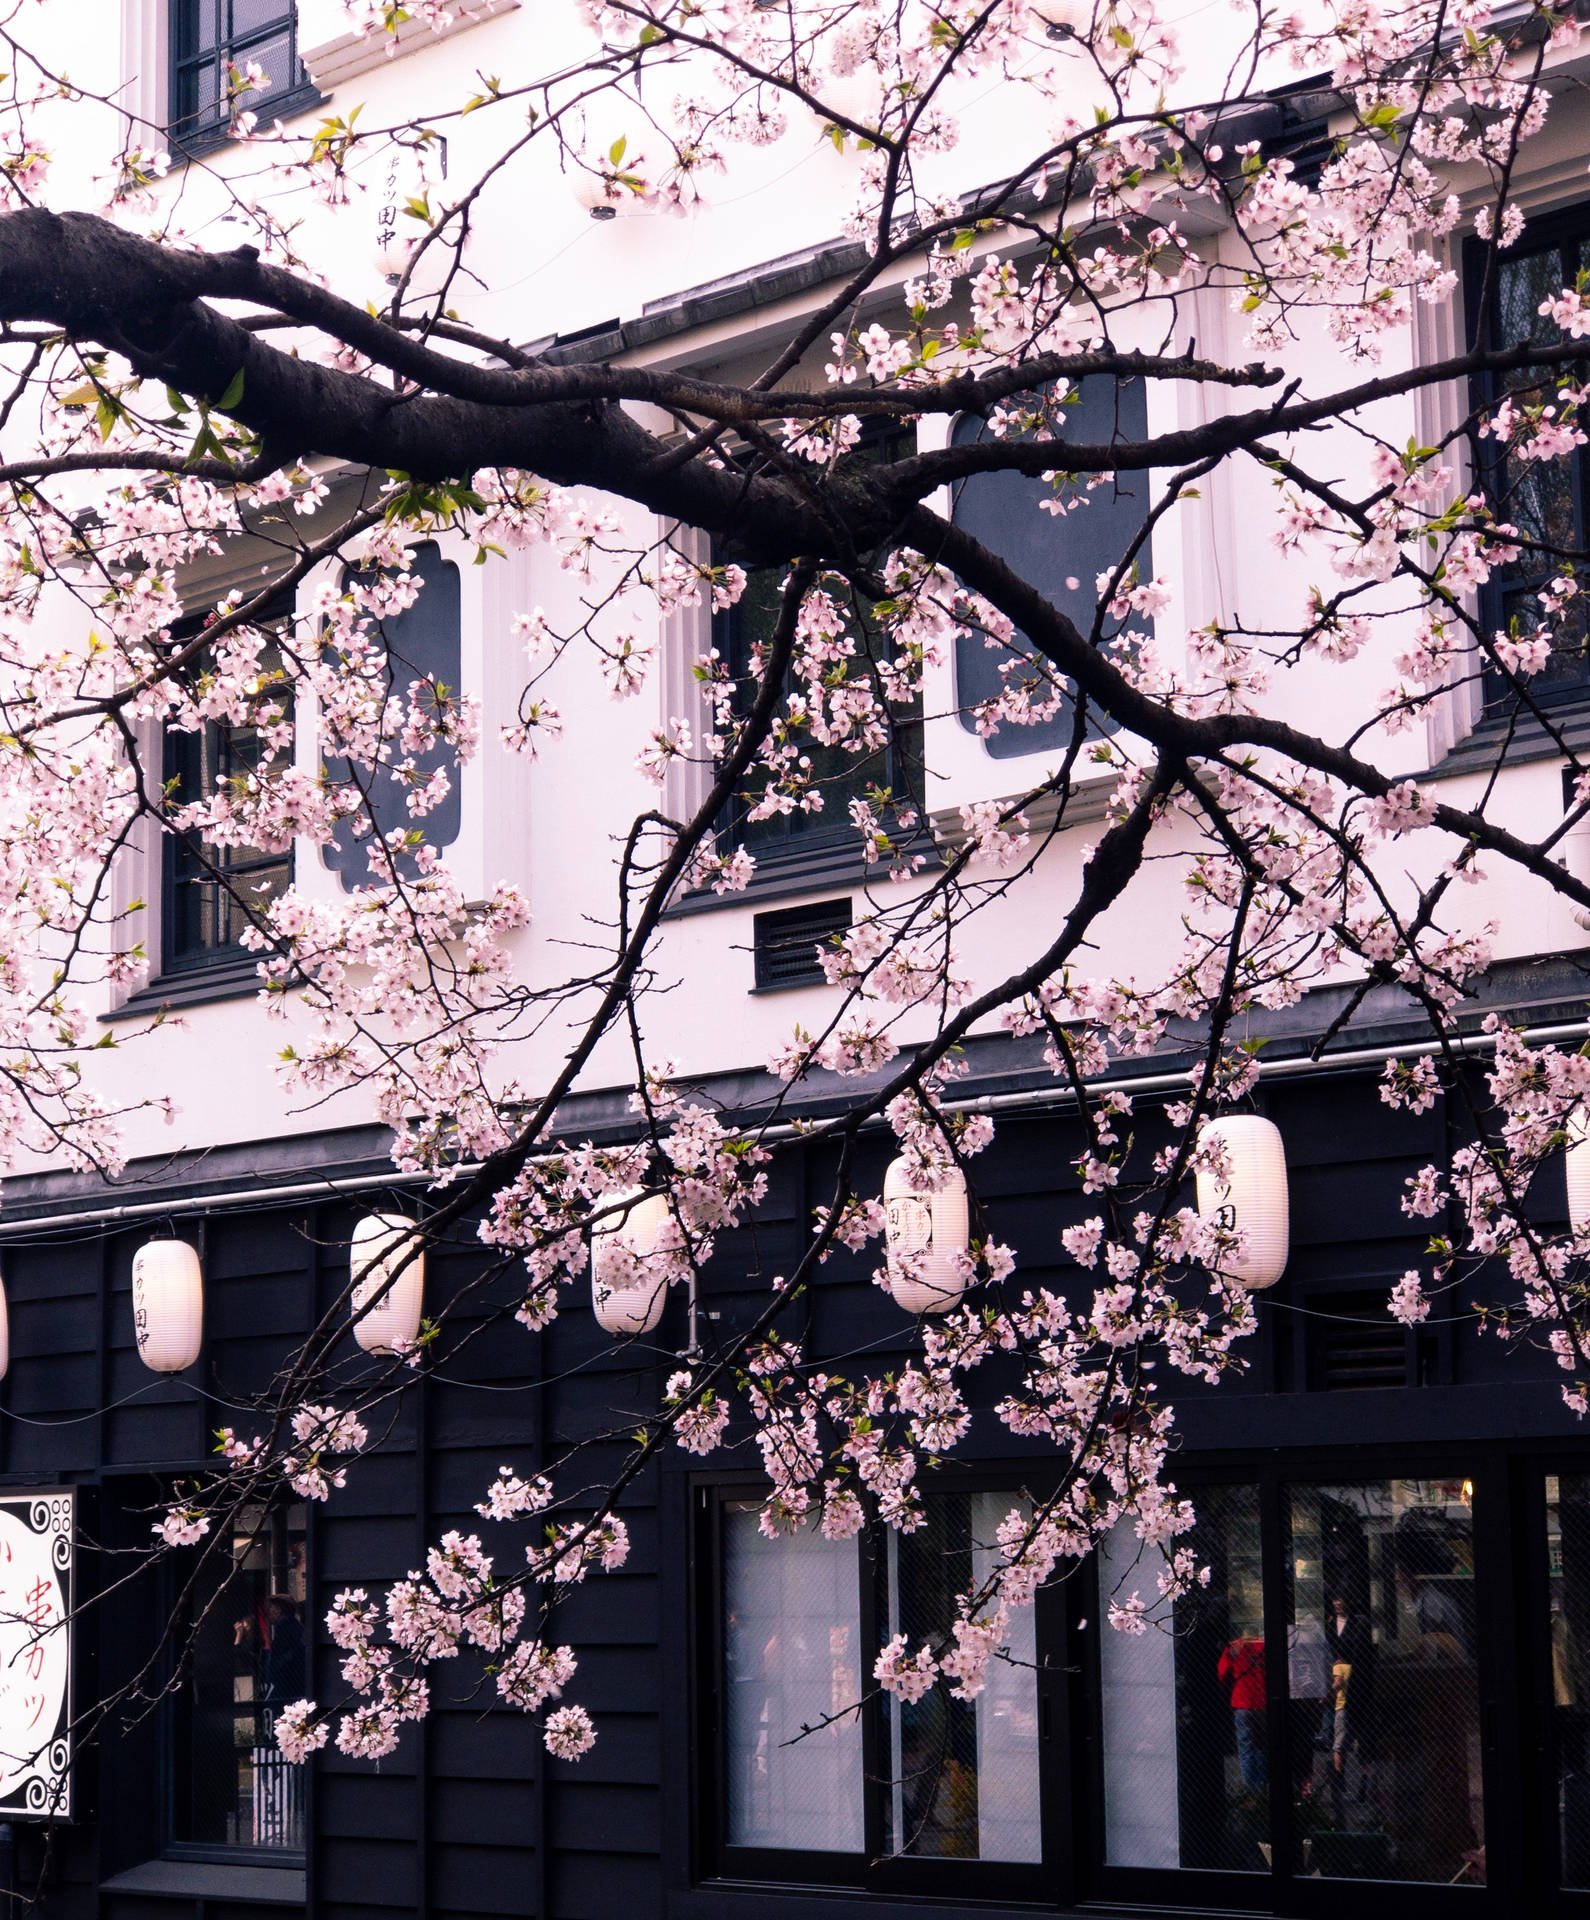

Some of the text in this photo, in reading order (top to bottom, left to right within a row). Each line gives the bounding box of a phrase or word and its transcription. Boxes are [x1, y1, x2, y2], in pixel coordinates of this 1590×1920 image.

[377, 157, 400, 252] 串カツ田中
[135, 1259, 150, 1353] 串カツ田中
[23, 1574, 53, 1730] 串カツ
